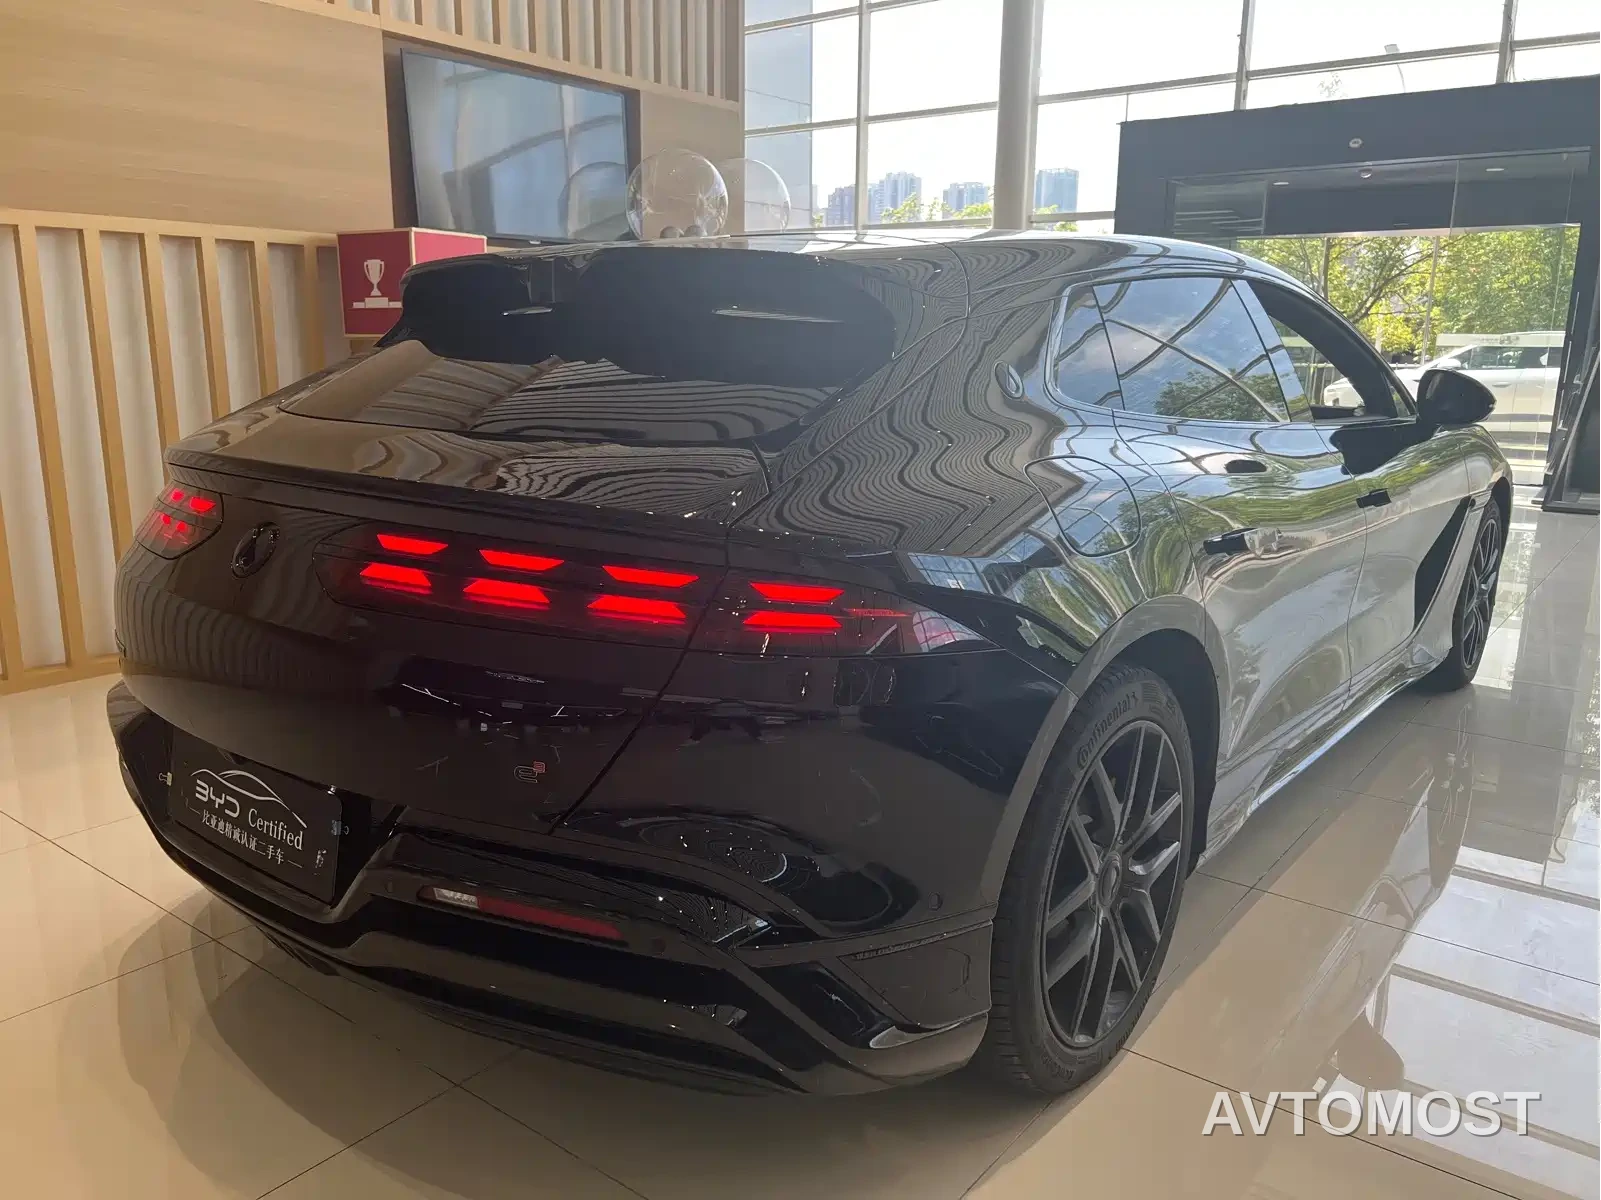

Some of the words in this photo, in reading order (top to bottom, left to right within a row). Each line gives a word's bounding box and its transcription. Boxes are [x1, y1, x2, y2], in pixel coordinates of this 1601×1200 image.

[1077, 693, 1133, 769] Continental
[195, 778, 241, 818] BYD
[248, 808, 304, 850] Certified
